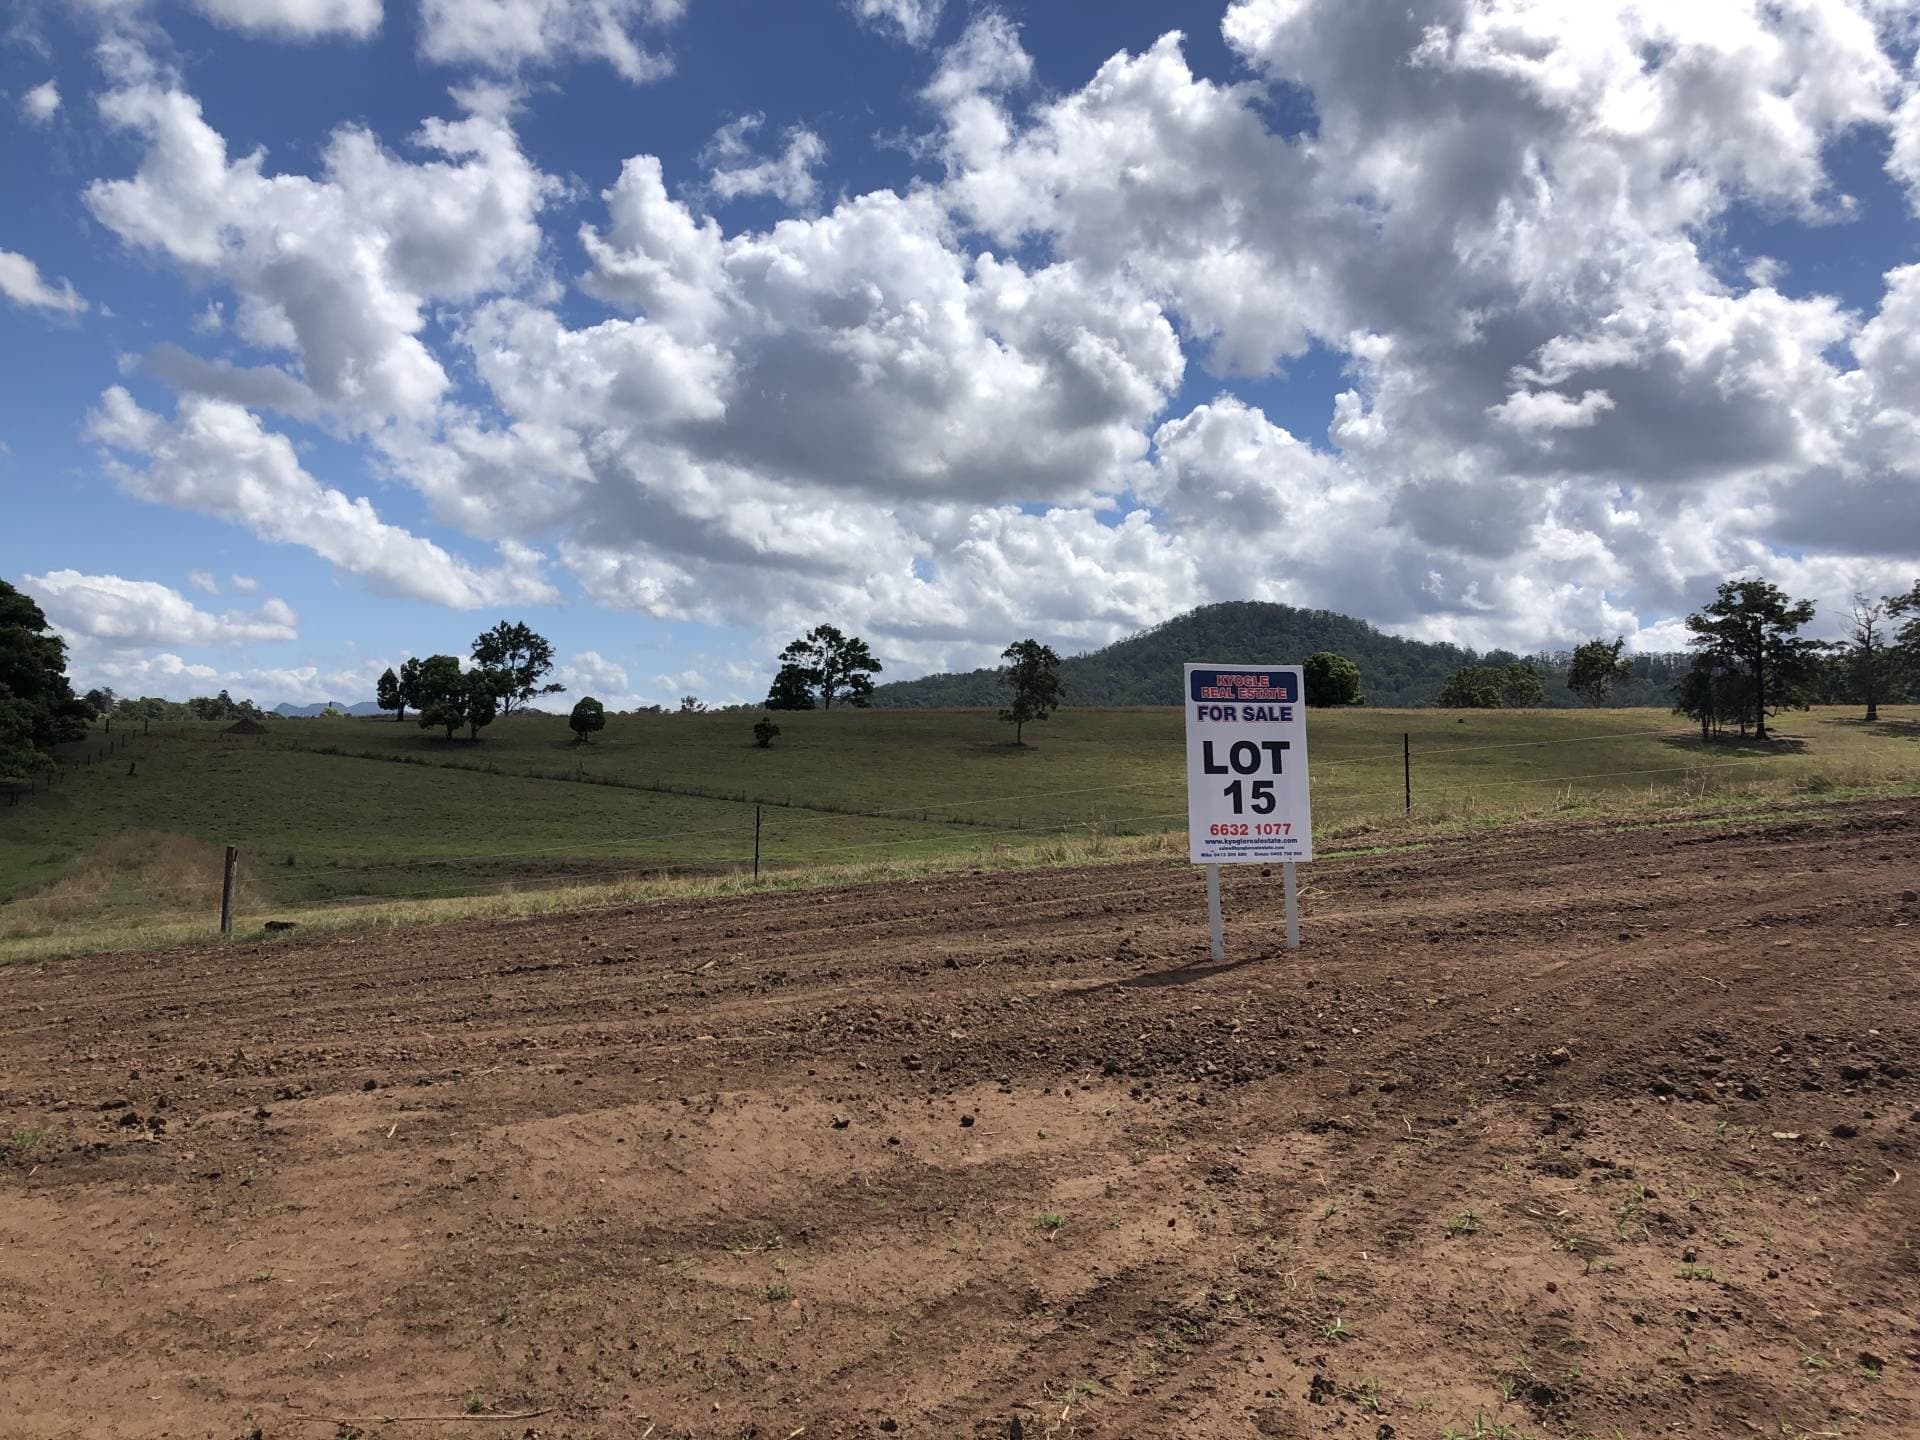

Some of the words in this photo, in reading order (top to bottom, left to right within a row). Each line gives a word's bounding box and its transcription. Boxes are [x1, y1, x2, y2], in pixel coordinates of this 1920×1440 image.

[1216, 674, 1270, 687] KYOGLE
[1201, 687, 1236, 699] REAL
[1238, 687, 1287, 700] ESTATE
[1197, 705, 1237, 722] FOR
[1242, 705, 1294, 723] SALE
[1202, 740, 1290, 775] LOT
[1223, 780, 1276, 815] 15
[1210, 823, 1249, 836] 6632
[1254, 823, 1292, 836] 1077
[1204, 837, 1298, 846] www.kyoglerealestate.com
